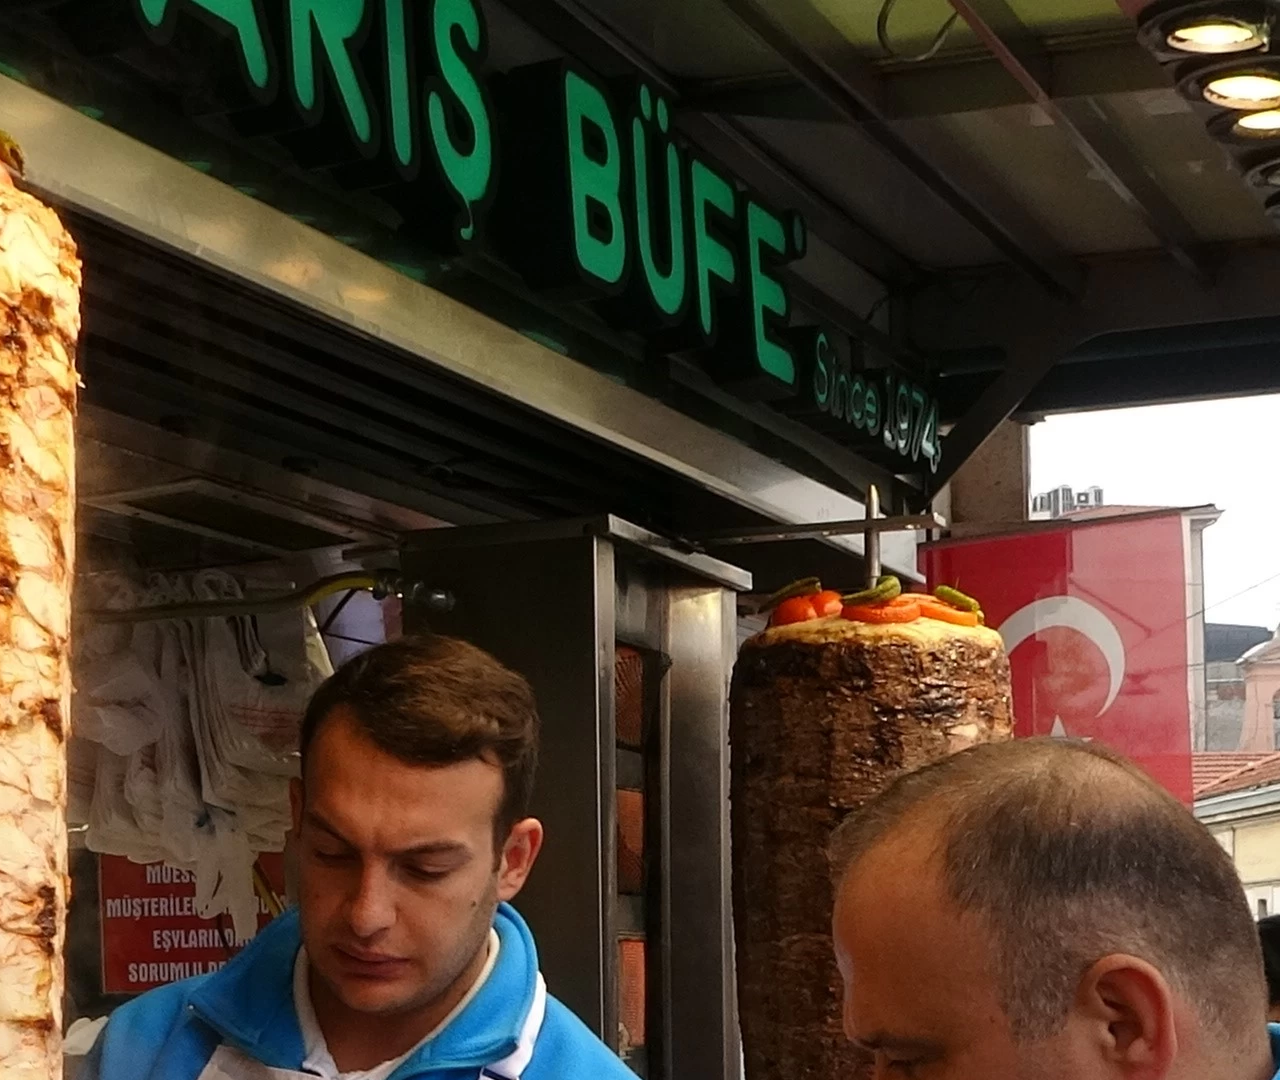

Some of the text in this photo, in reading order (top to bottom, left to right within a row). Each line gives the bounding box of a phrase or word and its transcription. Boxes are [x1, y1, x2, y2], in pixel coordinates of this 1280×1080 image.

[566, 70, 795, 385] BÜFE
[814, 332, 941, 474] Since 1974
